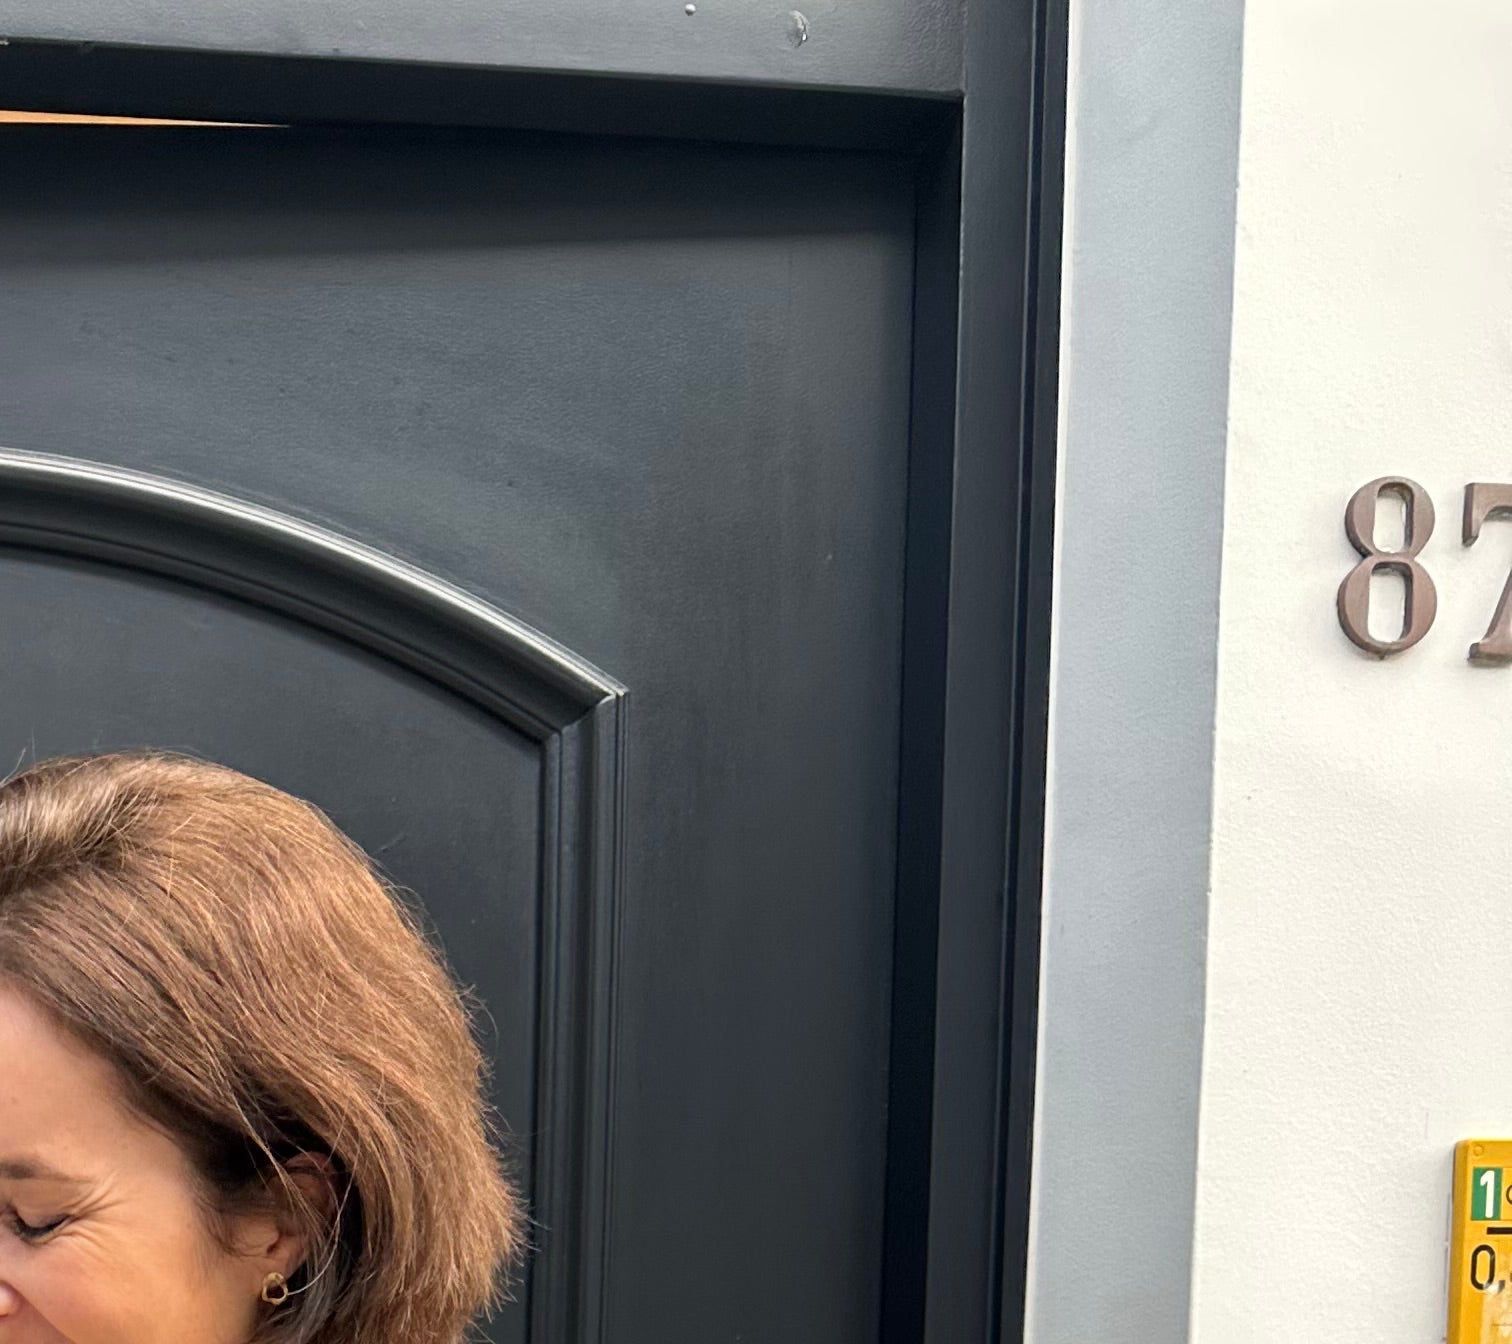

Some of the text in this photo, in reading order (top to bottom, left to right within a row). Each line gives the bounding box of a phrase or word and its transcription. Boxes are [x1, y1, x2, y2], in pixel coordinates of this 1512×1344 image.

[1336, 475, 1512, 664] 87
[1479, 1169, 1495, 1218] 1
[1471, 1244, 1512, 1293] 0,
